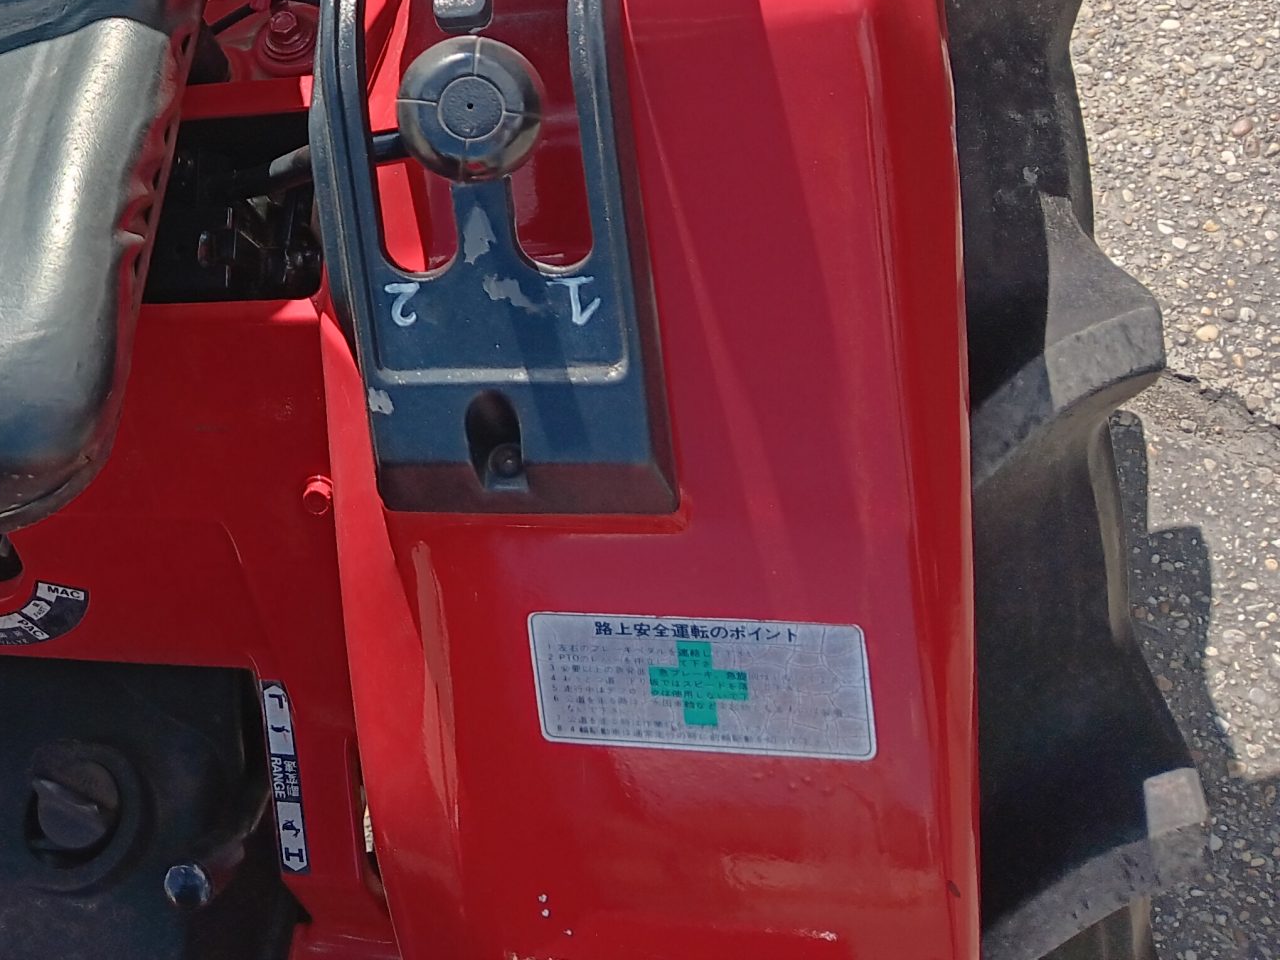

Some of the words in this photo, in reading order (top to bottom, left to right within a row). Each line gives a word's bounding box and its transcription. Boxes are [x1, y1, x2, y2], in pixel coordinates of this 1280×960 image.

[384, 281, 421, 327] 2
[545, 275, 602, 326] 1
[47, 585, 81, 599] MAC
[17, 619, 45, 639] PAC
[594, 620, 799, 644] 路上安全運転のポイント
[271, 756, 287, 800] RANGE
[283, 846, 305, 863] H
